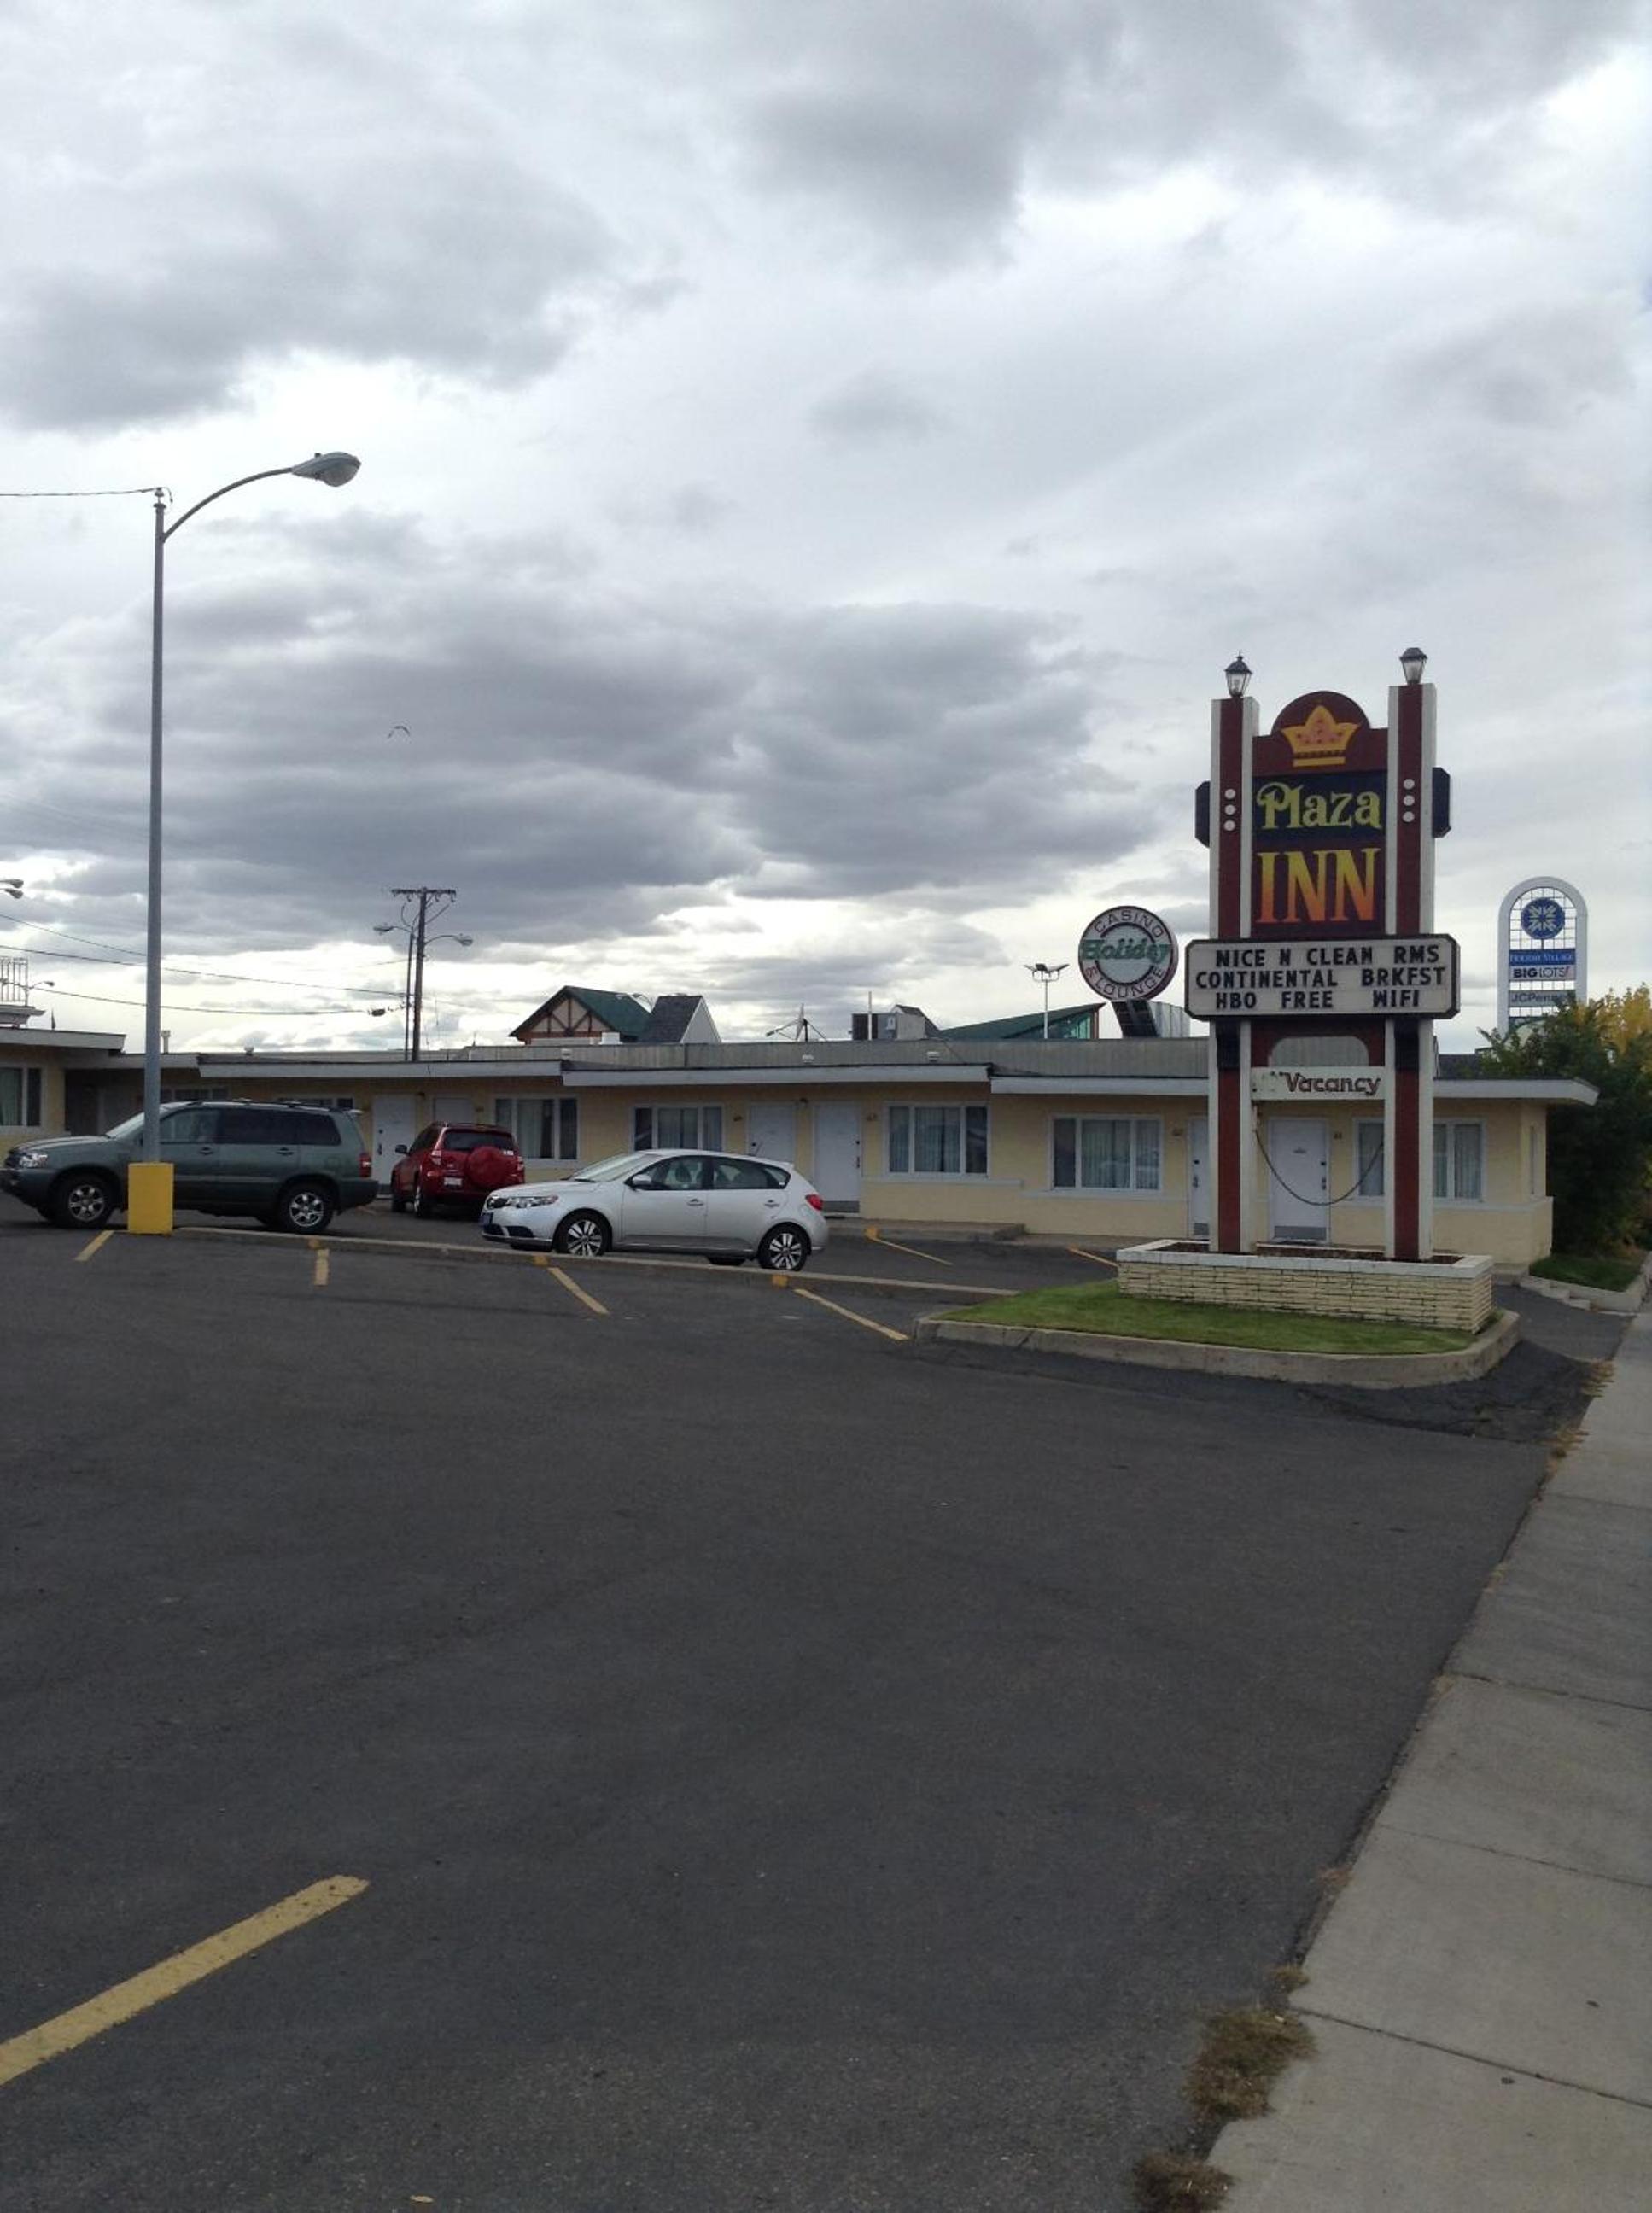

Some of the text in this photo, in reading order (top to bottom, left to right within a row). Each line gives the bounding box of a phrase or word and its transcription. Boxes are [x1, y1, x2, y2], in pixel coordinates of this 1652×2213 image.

[1256, 781, 1382, 830] Plaza
[1257, 847, 1381, 923] INN
[1094, 909, 1164, 938] CASINO
[1216, 945, 1439, 967] NICE N CLEAN RMS
[1095, 965, 1165, 998] LOUNGE
[1196, 966, 1445, 989] CONTINENTAL BRKFST
[1513, 967, 1538, 978] BIG
[1216, 990, 1419, 1009] HBO FREE WIFI
[1281, 1072, 1381, 1096] Vacancy
